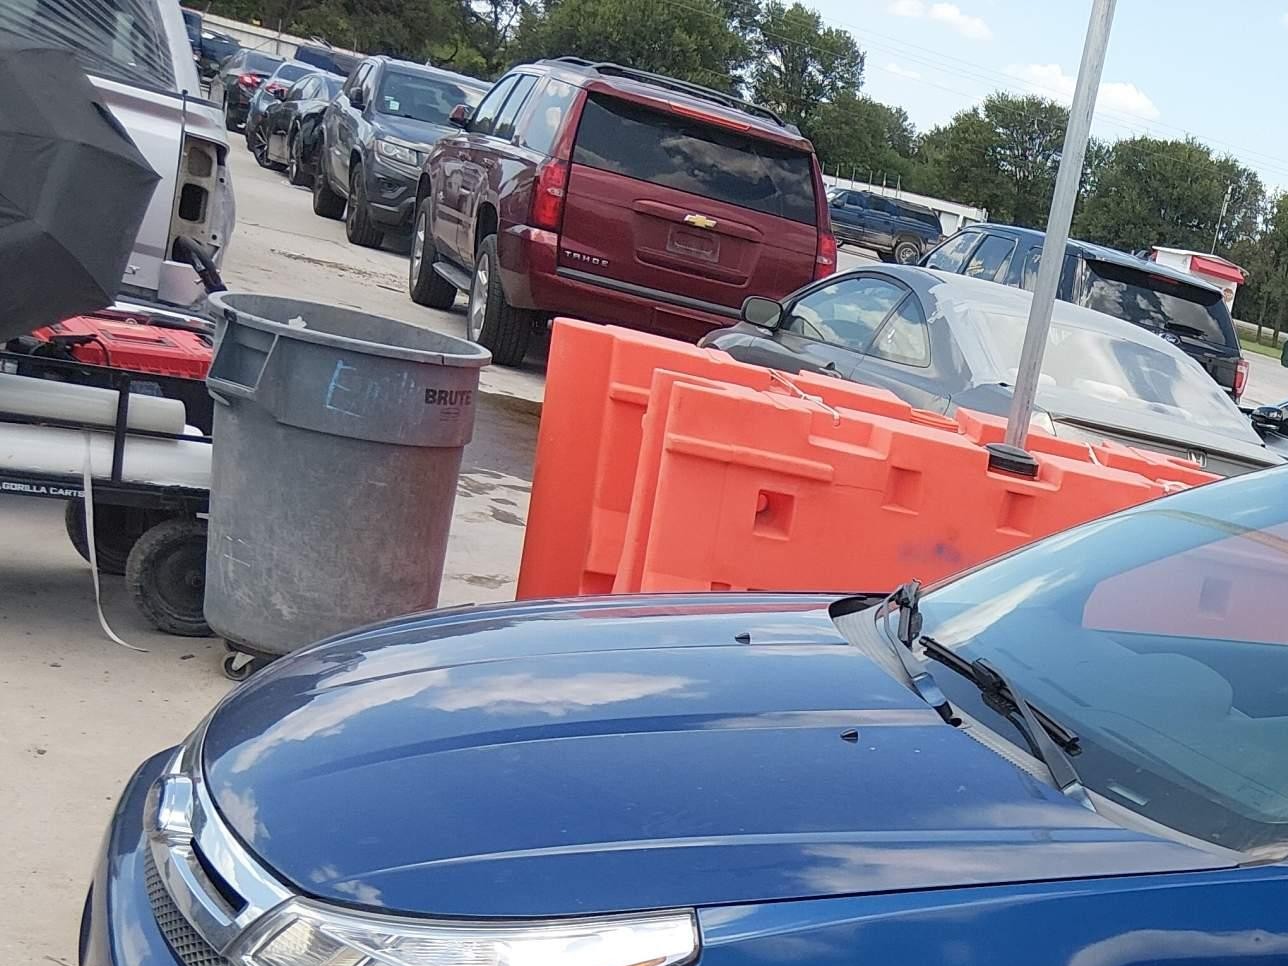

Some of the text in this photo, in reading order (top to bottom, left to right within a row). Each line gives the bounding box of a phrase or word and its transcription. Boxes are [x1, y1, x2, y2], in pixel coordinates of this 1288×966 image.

[563, 250, 609, 267] TAHOE
[424, 388, 472, 406] BRUTE
[2, 482, 87, 498] GORILLA CARTS
